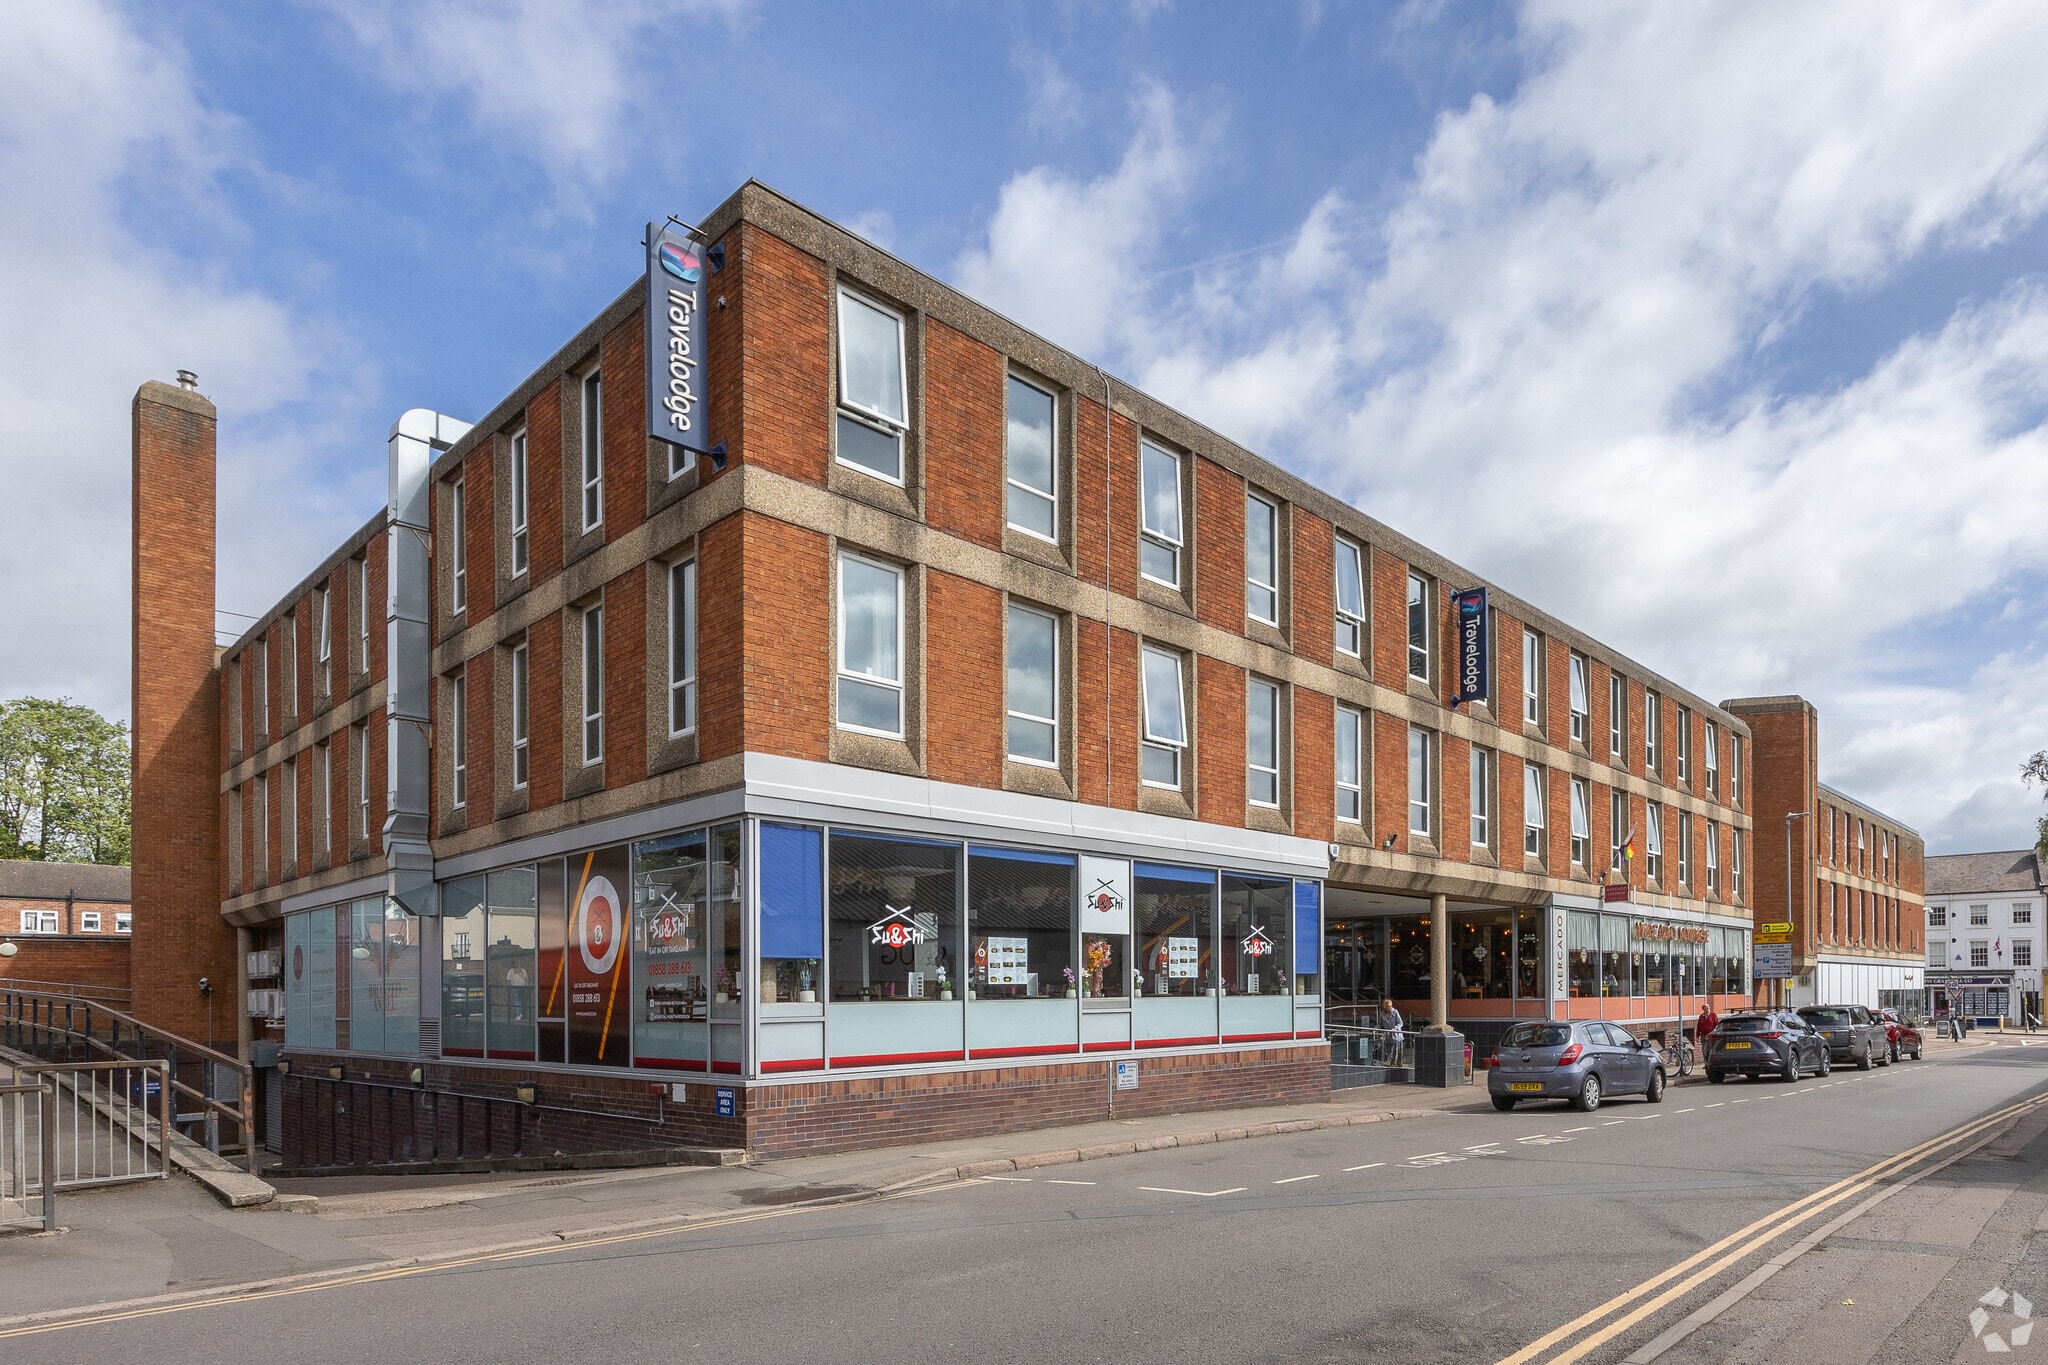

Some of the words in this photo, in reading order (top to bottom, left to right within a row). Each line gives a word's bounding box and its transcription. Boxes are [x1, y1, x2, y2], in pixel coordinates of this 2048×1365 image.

[664, 288, 698, 431] Travelodge
[1464, 615, 1480, 693] Travelodge
[1634, 921, 1676, 940] MERCADO
[1678, 926, 1709, 943] LOUNGE
[717, 1090, 733, 1098] SERVICE
